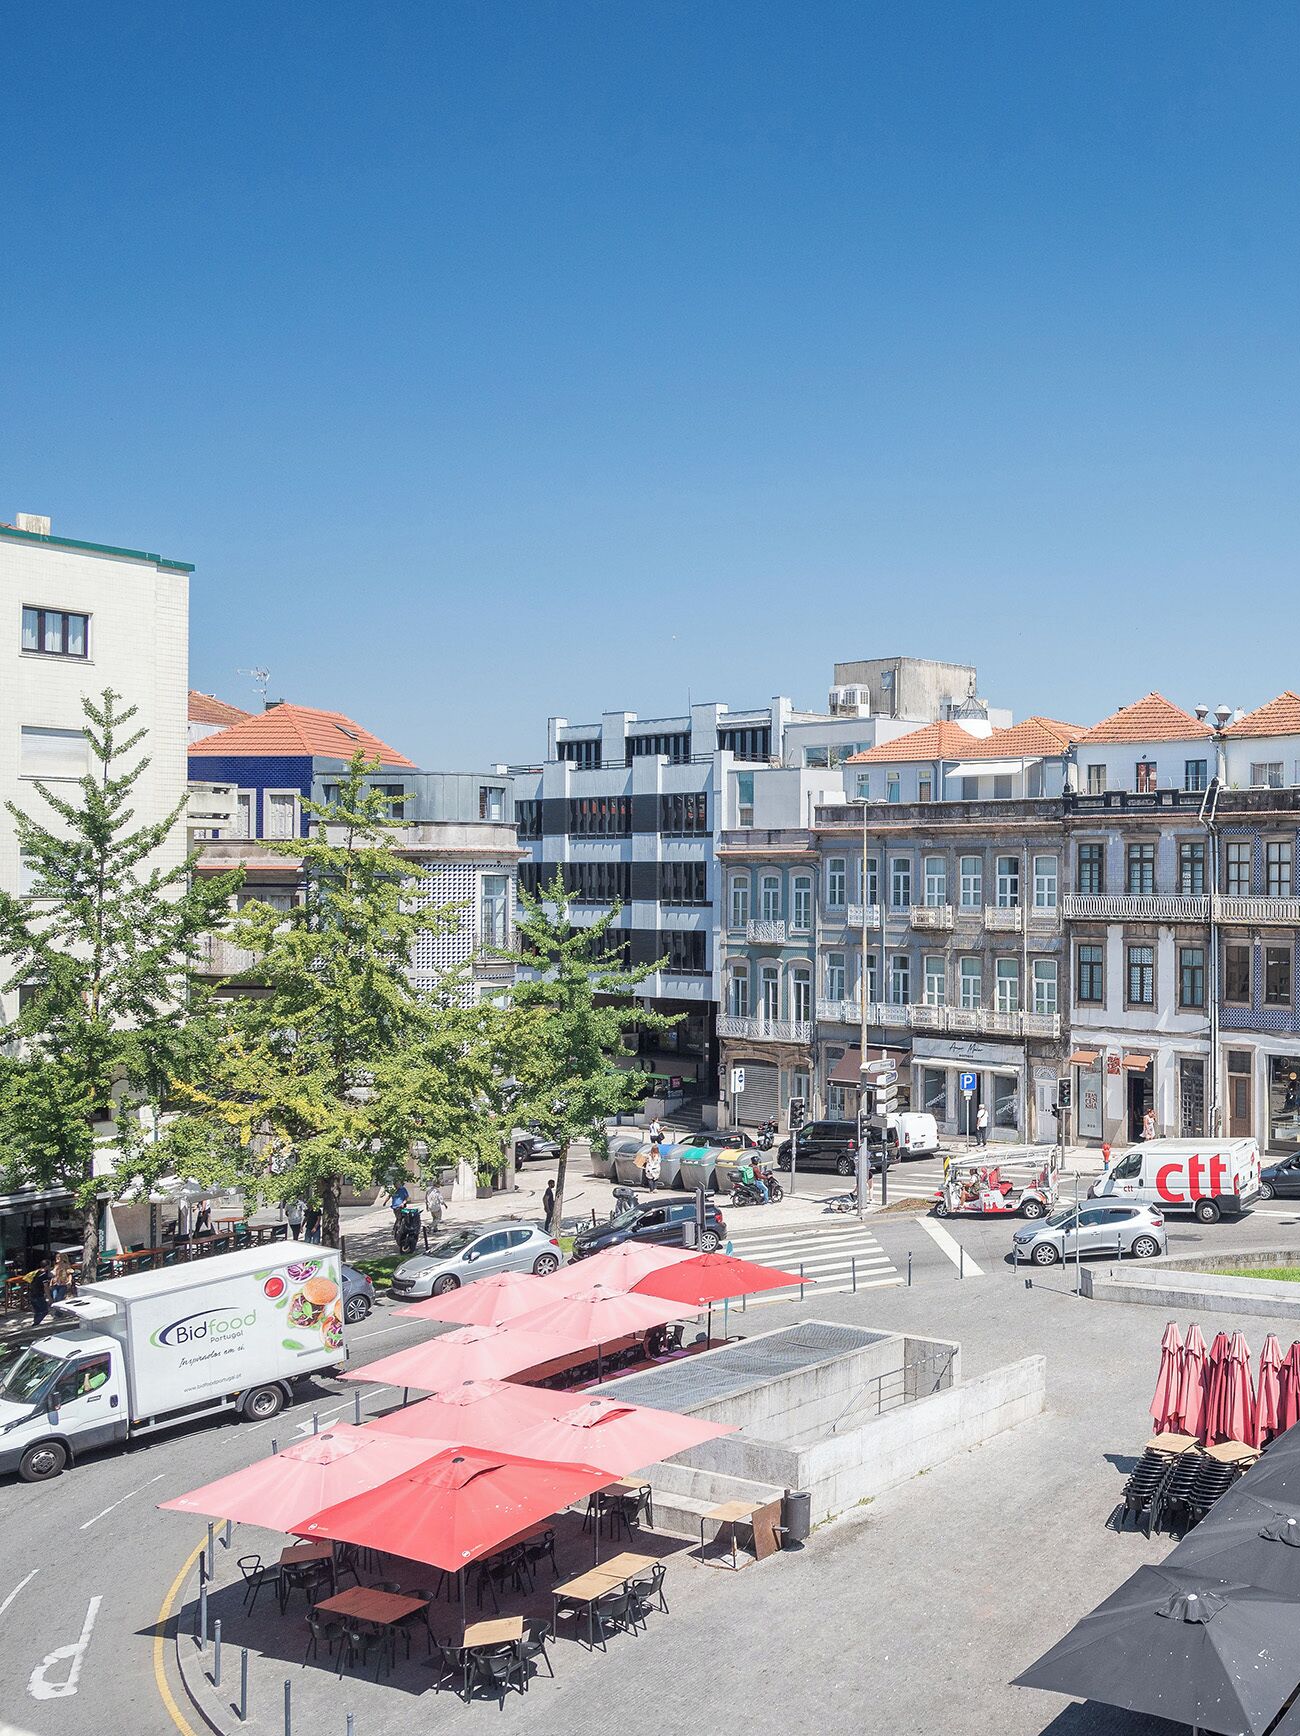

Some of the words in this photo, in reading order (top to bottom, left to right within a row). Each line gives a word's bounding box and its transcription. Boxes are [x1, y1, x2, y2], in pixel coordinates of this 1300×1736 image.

[963, 1075, 972, 1088] P
[1156, 1153, 1227, 1203] ctt
[176, 1309, 256, 1344] Bidfood
[210, 1330, 244, 1343] Portugal
